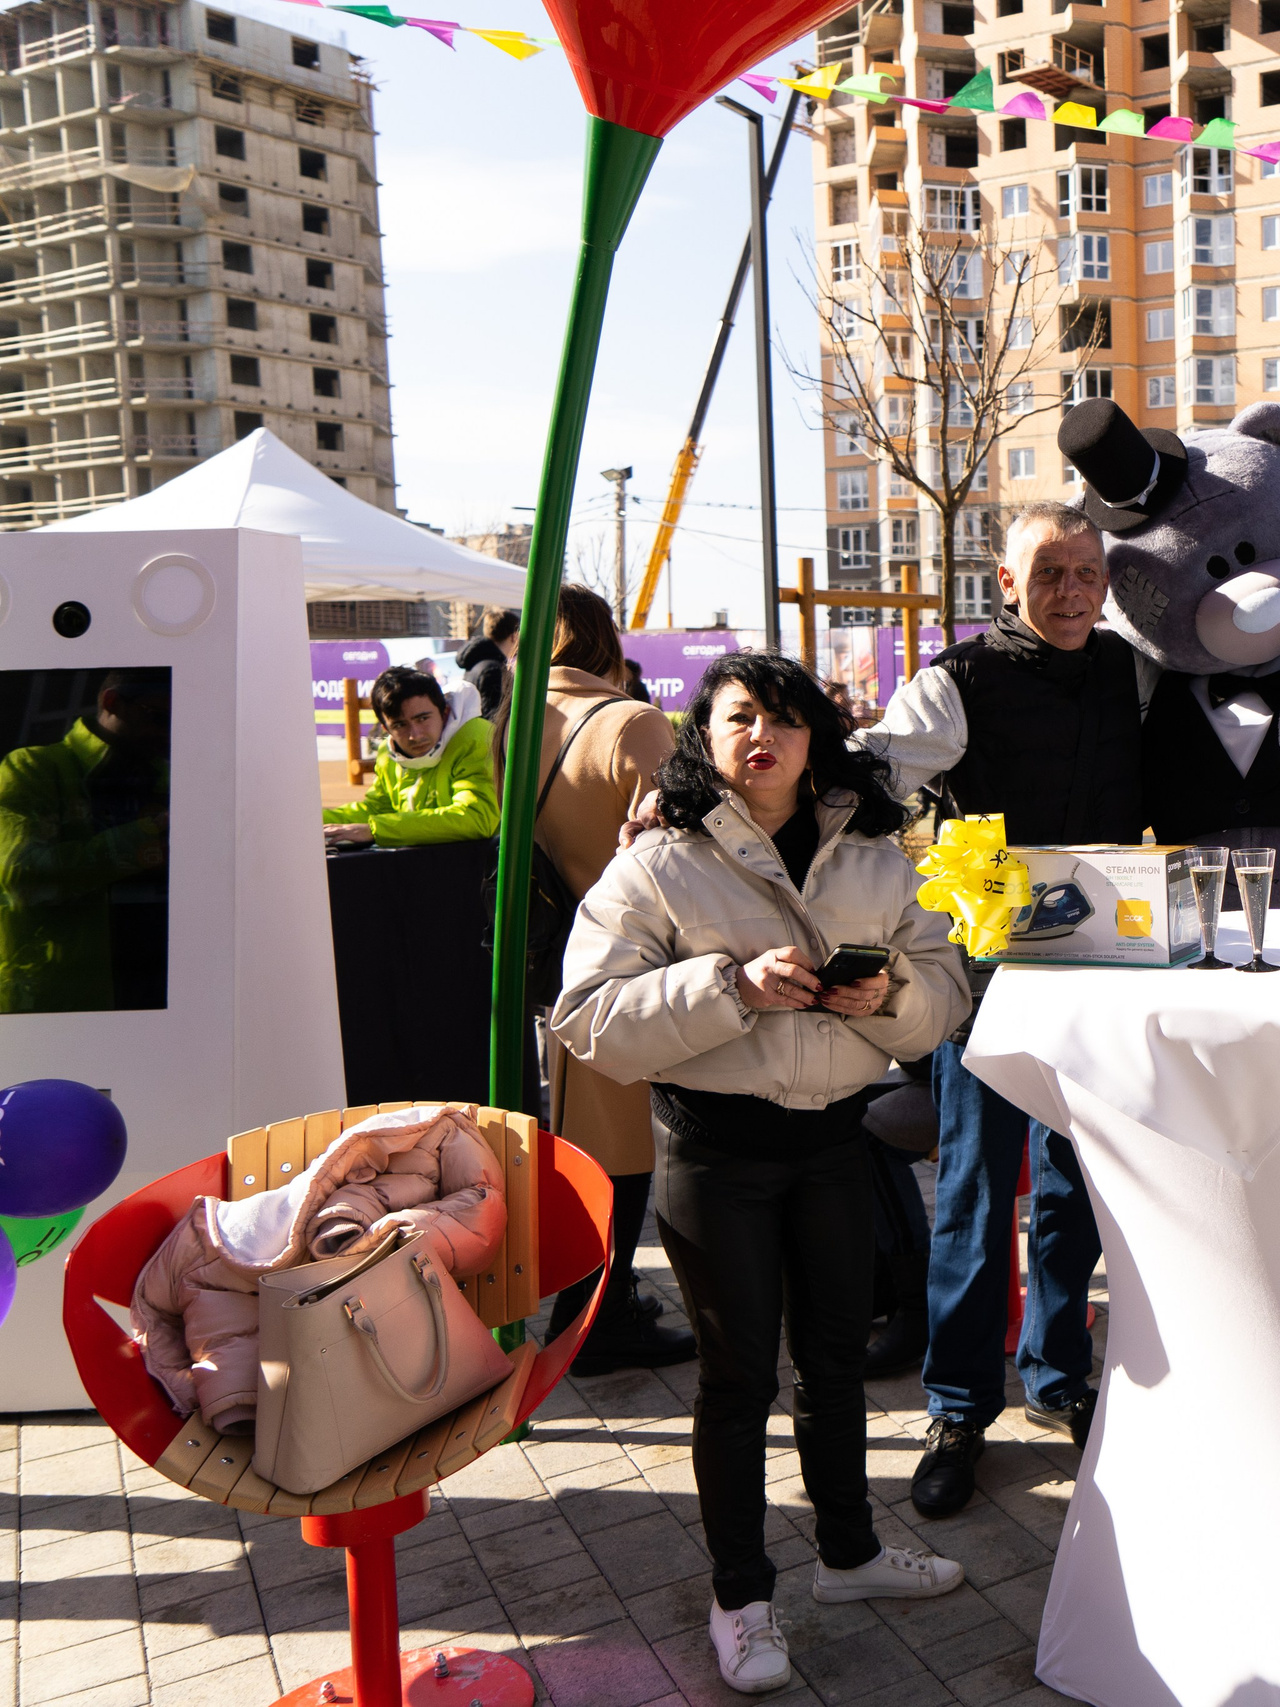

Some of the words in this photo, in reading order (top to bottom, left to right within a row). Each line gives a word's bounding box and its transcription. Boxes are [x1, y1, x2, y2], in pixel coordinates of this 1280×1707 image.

[641, 678, 685, 698] НТР
[1106, 866, 1136, 875] STEAM
[1138, 866, 1161, 875] IRON
